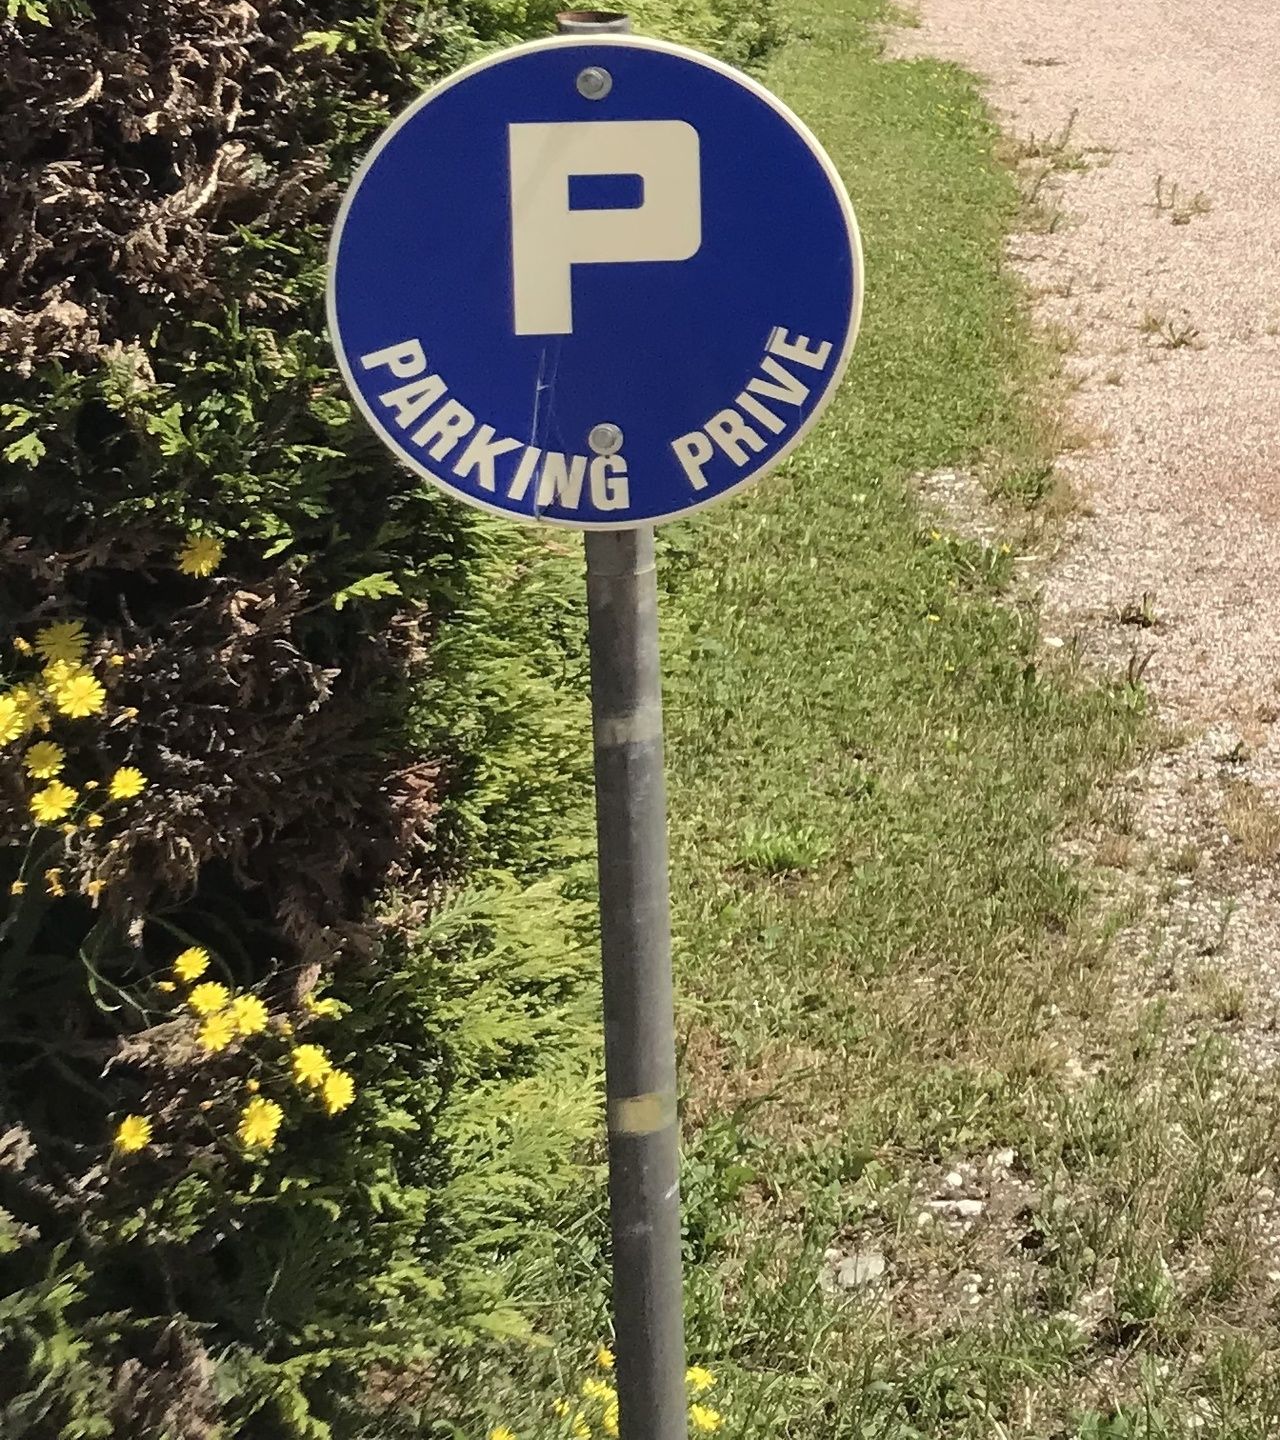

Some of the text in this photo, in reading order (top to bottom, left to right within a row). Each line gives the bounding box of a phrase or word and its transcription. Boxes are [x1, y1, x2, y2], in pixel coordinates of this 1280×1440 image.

[508, 118, 703, 337] P
[360, 325, 834, 511] PARKING PRIVE
